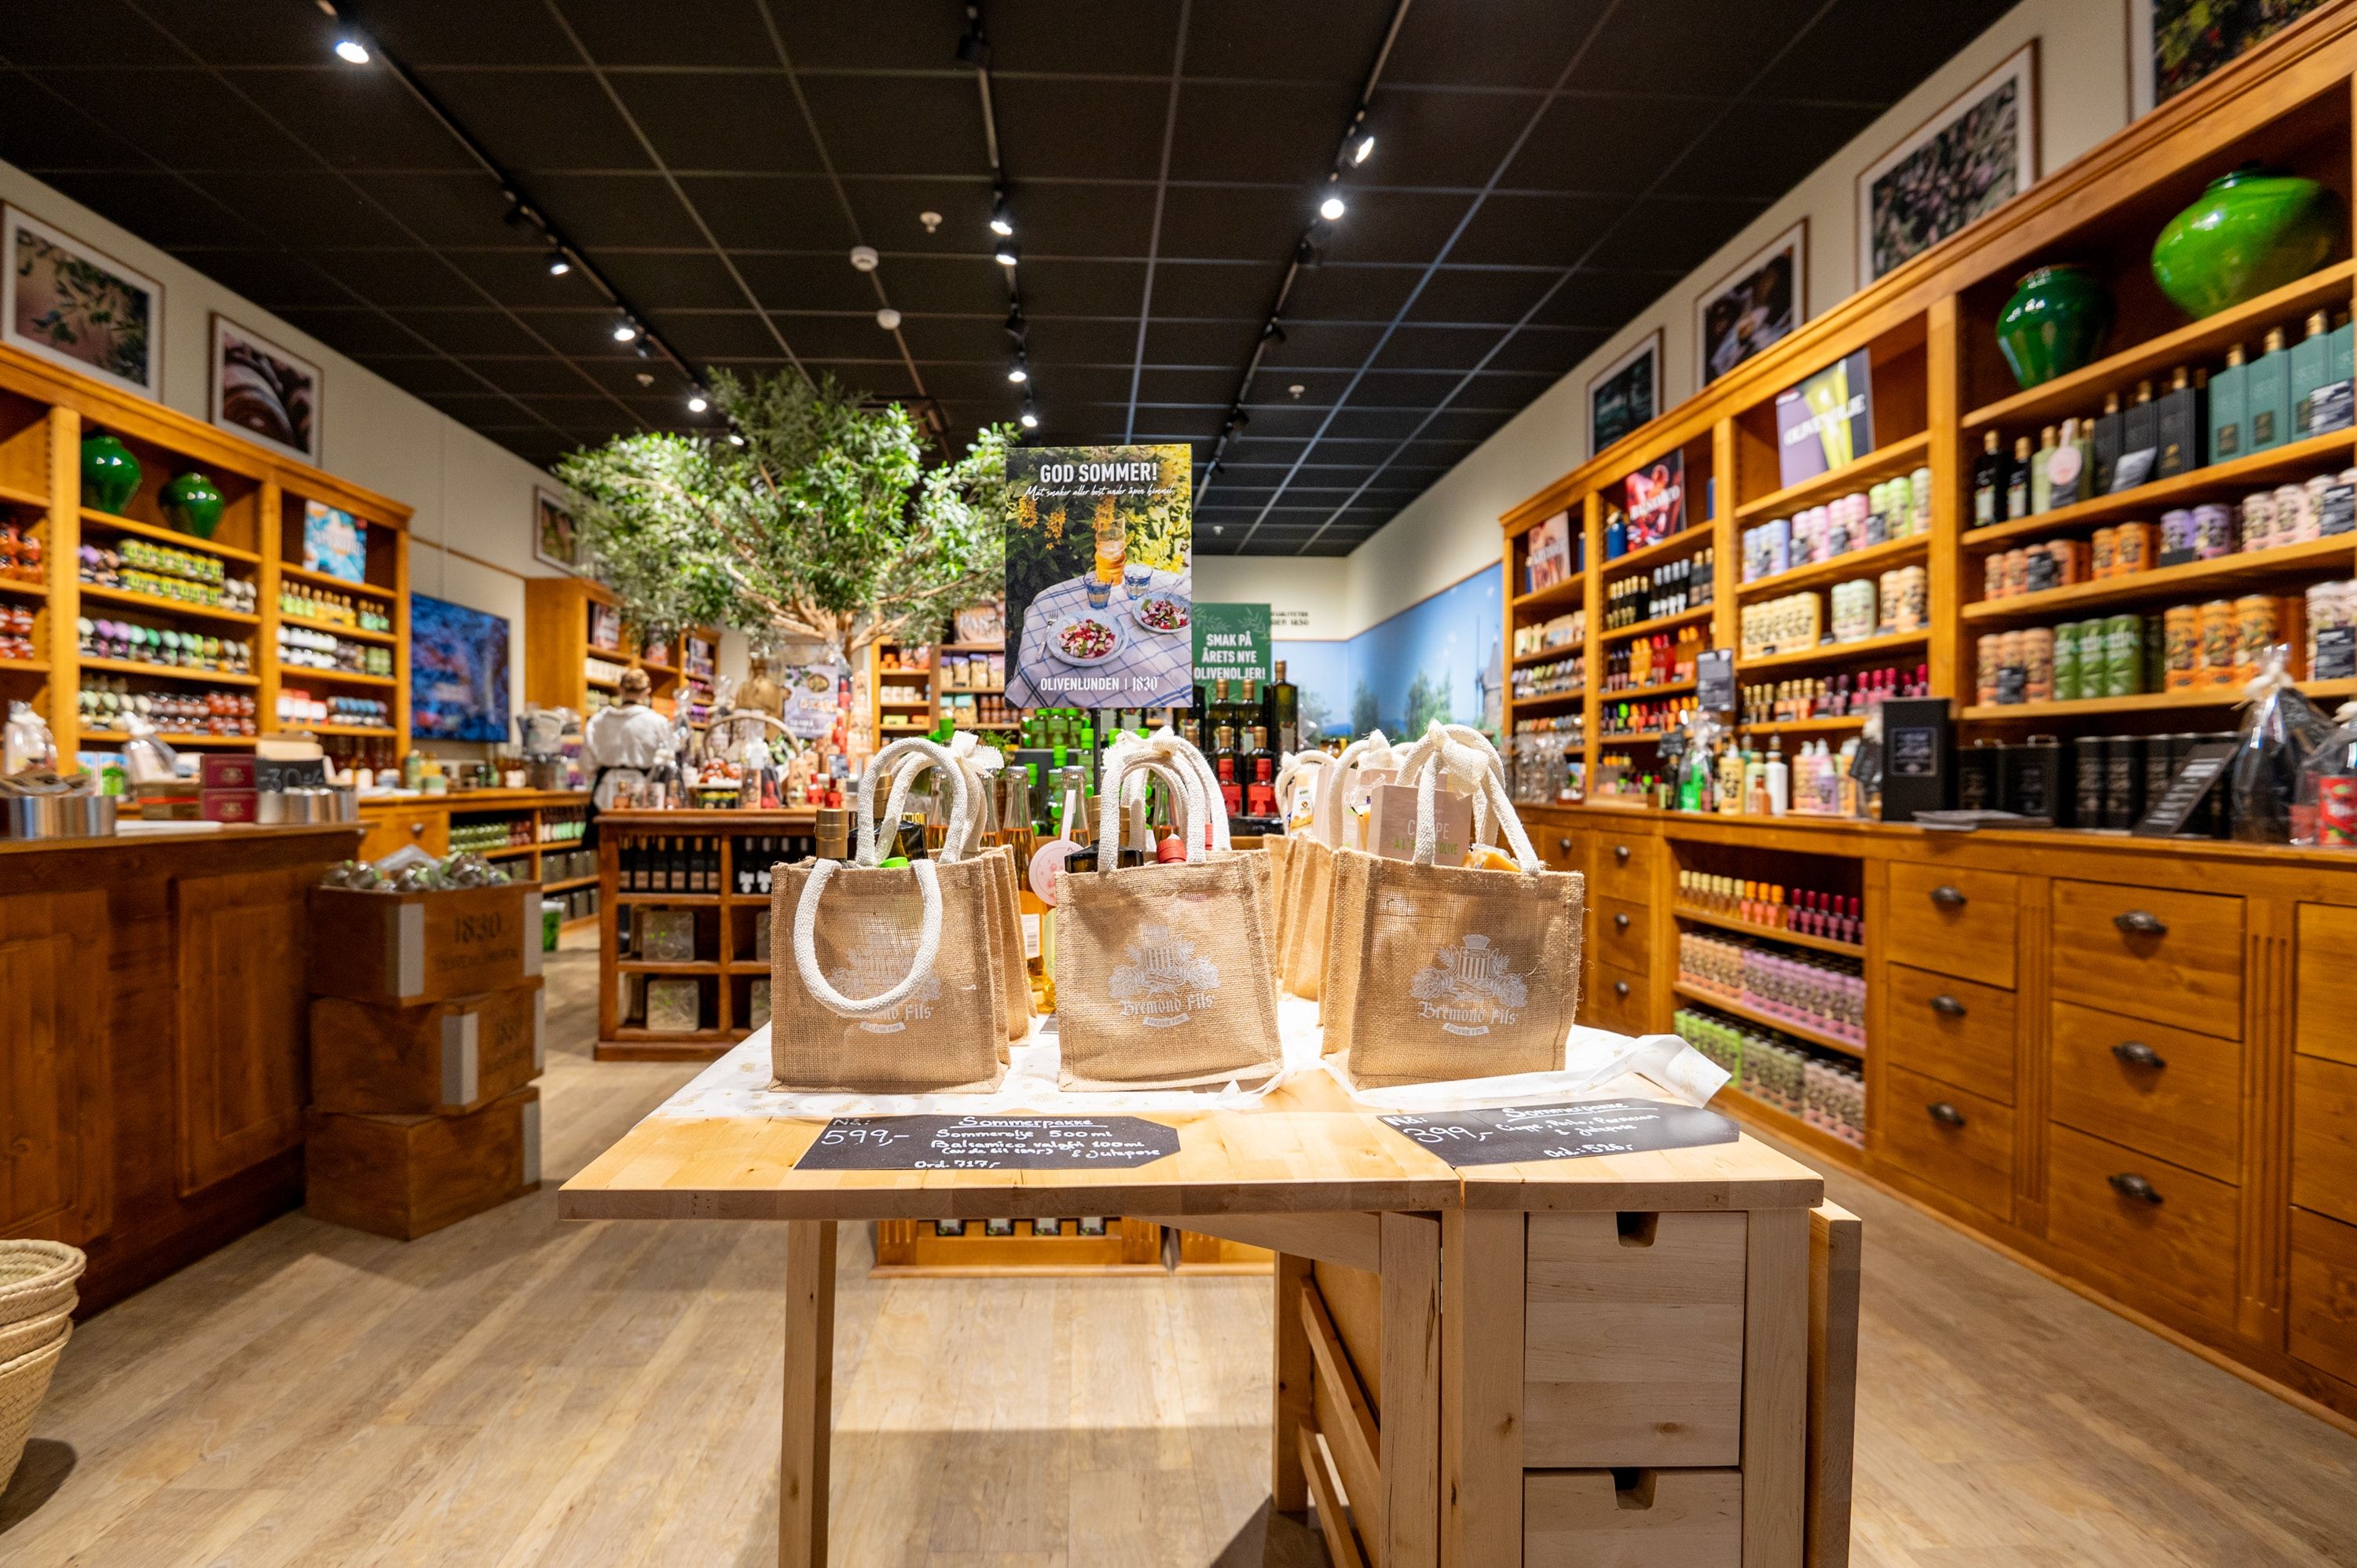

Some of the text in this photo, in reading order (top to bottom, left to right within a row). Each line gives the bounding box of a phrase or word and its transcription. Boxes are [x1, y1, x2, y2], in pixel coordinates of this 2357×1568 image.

[1040, 463, 1157, 482] GOD SOMMER!
[1025, 483, 1174, 501] Mat smaker aller best under åpen himmel
[1206, 630, 1252, 646] SMAK PÅ
[1201, 647, 1257, 663] ÅRETS NYE
[1193, 667, 1266, 680] OLIVENOLJER!
[1040, 676, 1158, 692] OLIVENLUNDEN 1830
[1187, 992, 1213, 1011] Fils
[905, 1002, 931, 1020] Fils
[1490, 1006, 1516, 1024] Fils
[959, 1116, 1093, 1129] Sommerpakke
[821, 1130, 910, 1146] 599,-
[936, 1129, 1034, 1140] Sommerolje
[931, 1140, 1026, 1149] Balsamico
